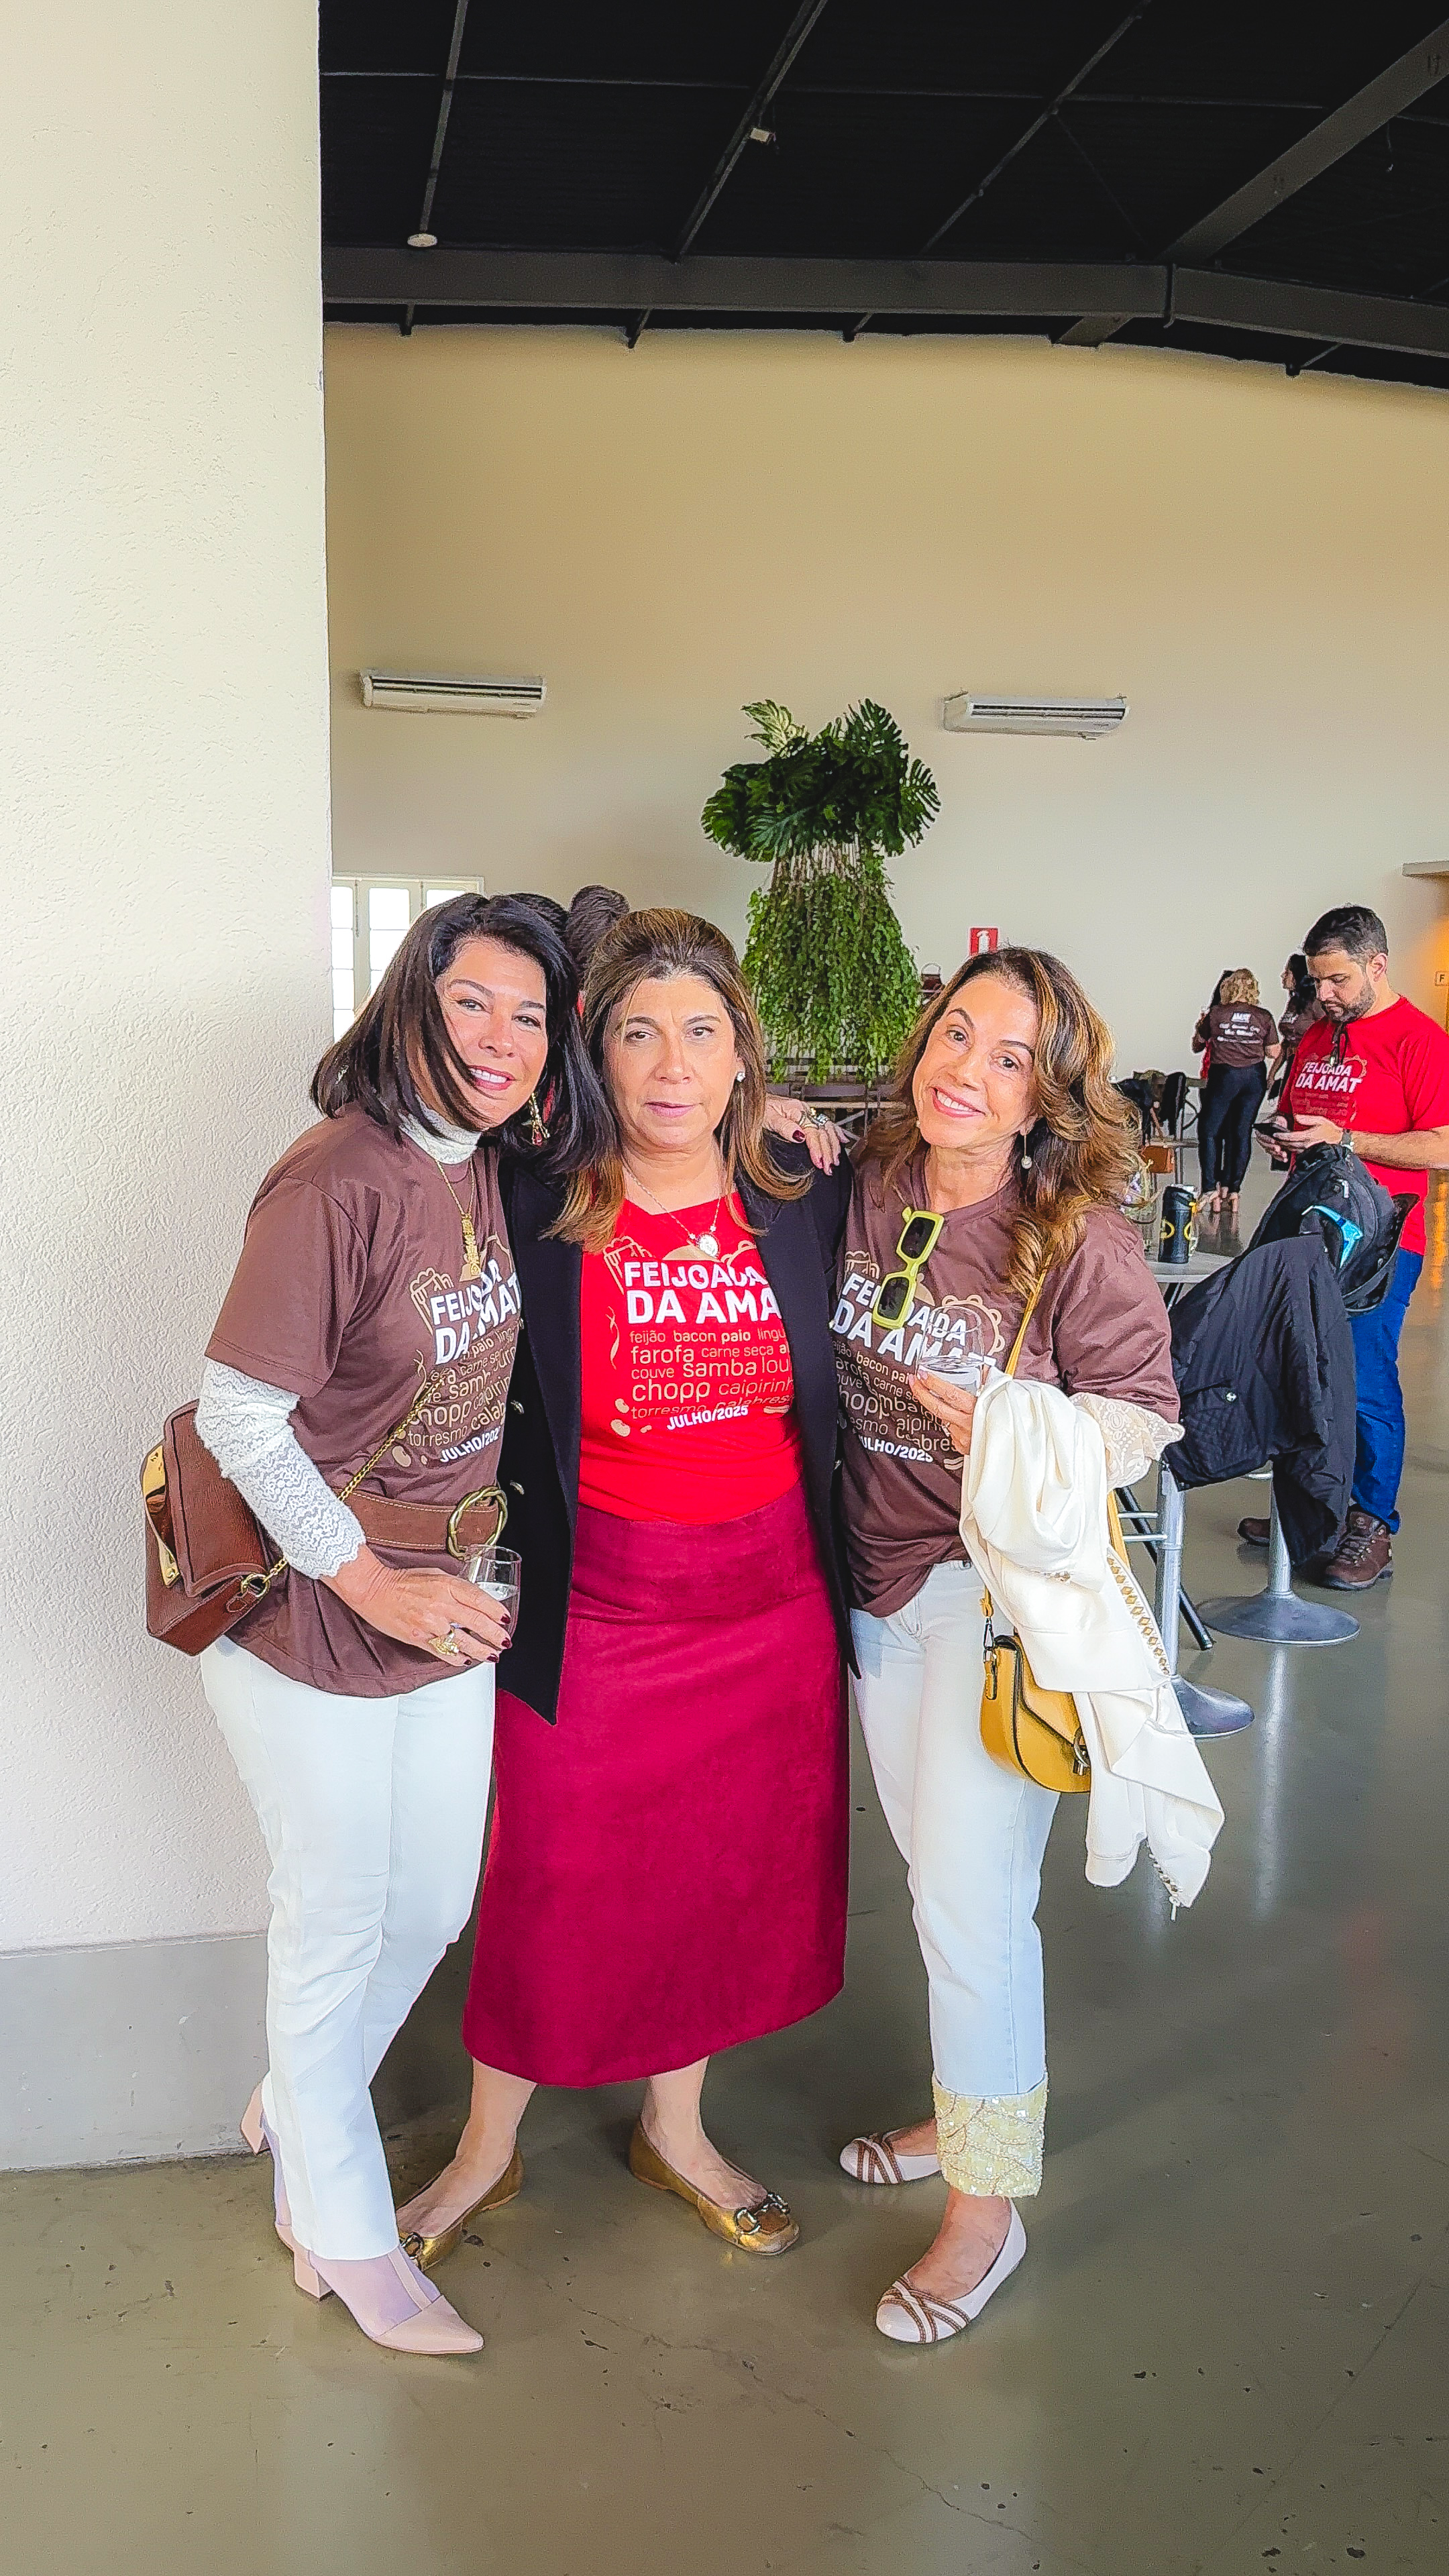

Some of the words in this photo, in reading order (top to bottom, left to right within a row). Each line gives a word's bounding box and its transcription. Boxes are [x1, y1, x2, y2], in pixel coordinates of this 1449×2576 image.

[1301, 1062, 1352, 1077] FEIJOADA
[1295, 1073, 1314, 1089] DA
[1314, 1075, 1362, 1093] AMAT
[627, 1289, 686, 1324] DA
[833, 1299, 872, 1348] DA
[435, 1322, 470, 1365] DA
[472, 1338, 494, 1358] paio
[629, 1330, 665, 1346] feijão
[673, 1330, 716, 1342] bacon
[721, 1329, 751, 1344] paio
[631, 1344, 694, 1364] farofa
[701, 1347, 739, 1358] carne
[744, 1345, 773, 1357] seca
[856, 1351, 889, 1376] bacon
[631, 1366, 674, 1380] couve
[682, 1358, 757, 1377] samba
[632, 1379, 710, 1403] chopp
[874, 1377, 903, 1397] carne
[667, 1405, 749, 1430] JULHO/2025
[408, 1426, 468, 1447] torresmo
[440, 1426, 501, 1463] JULHO/202
